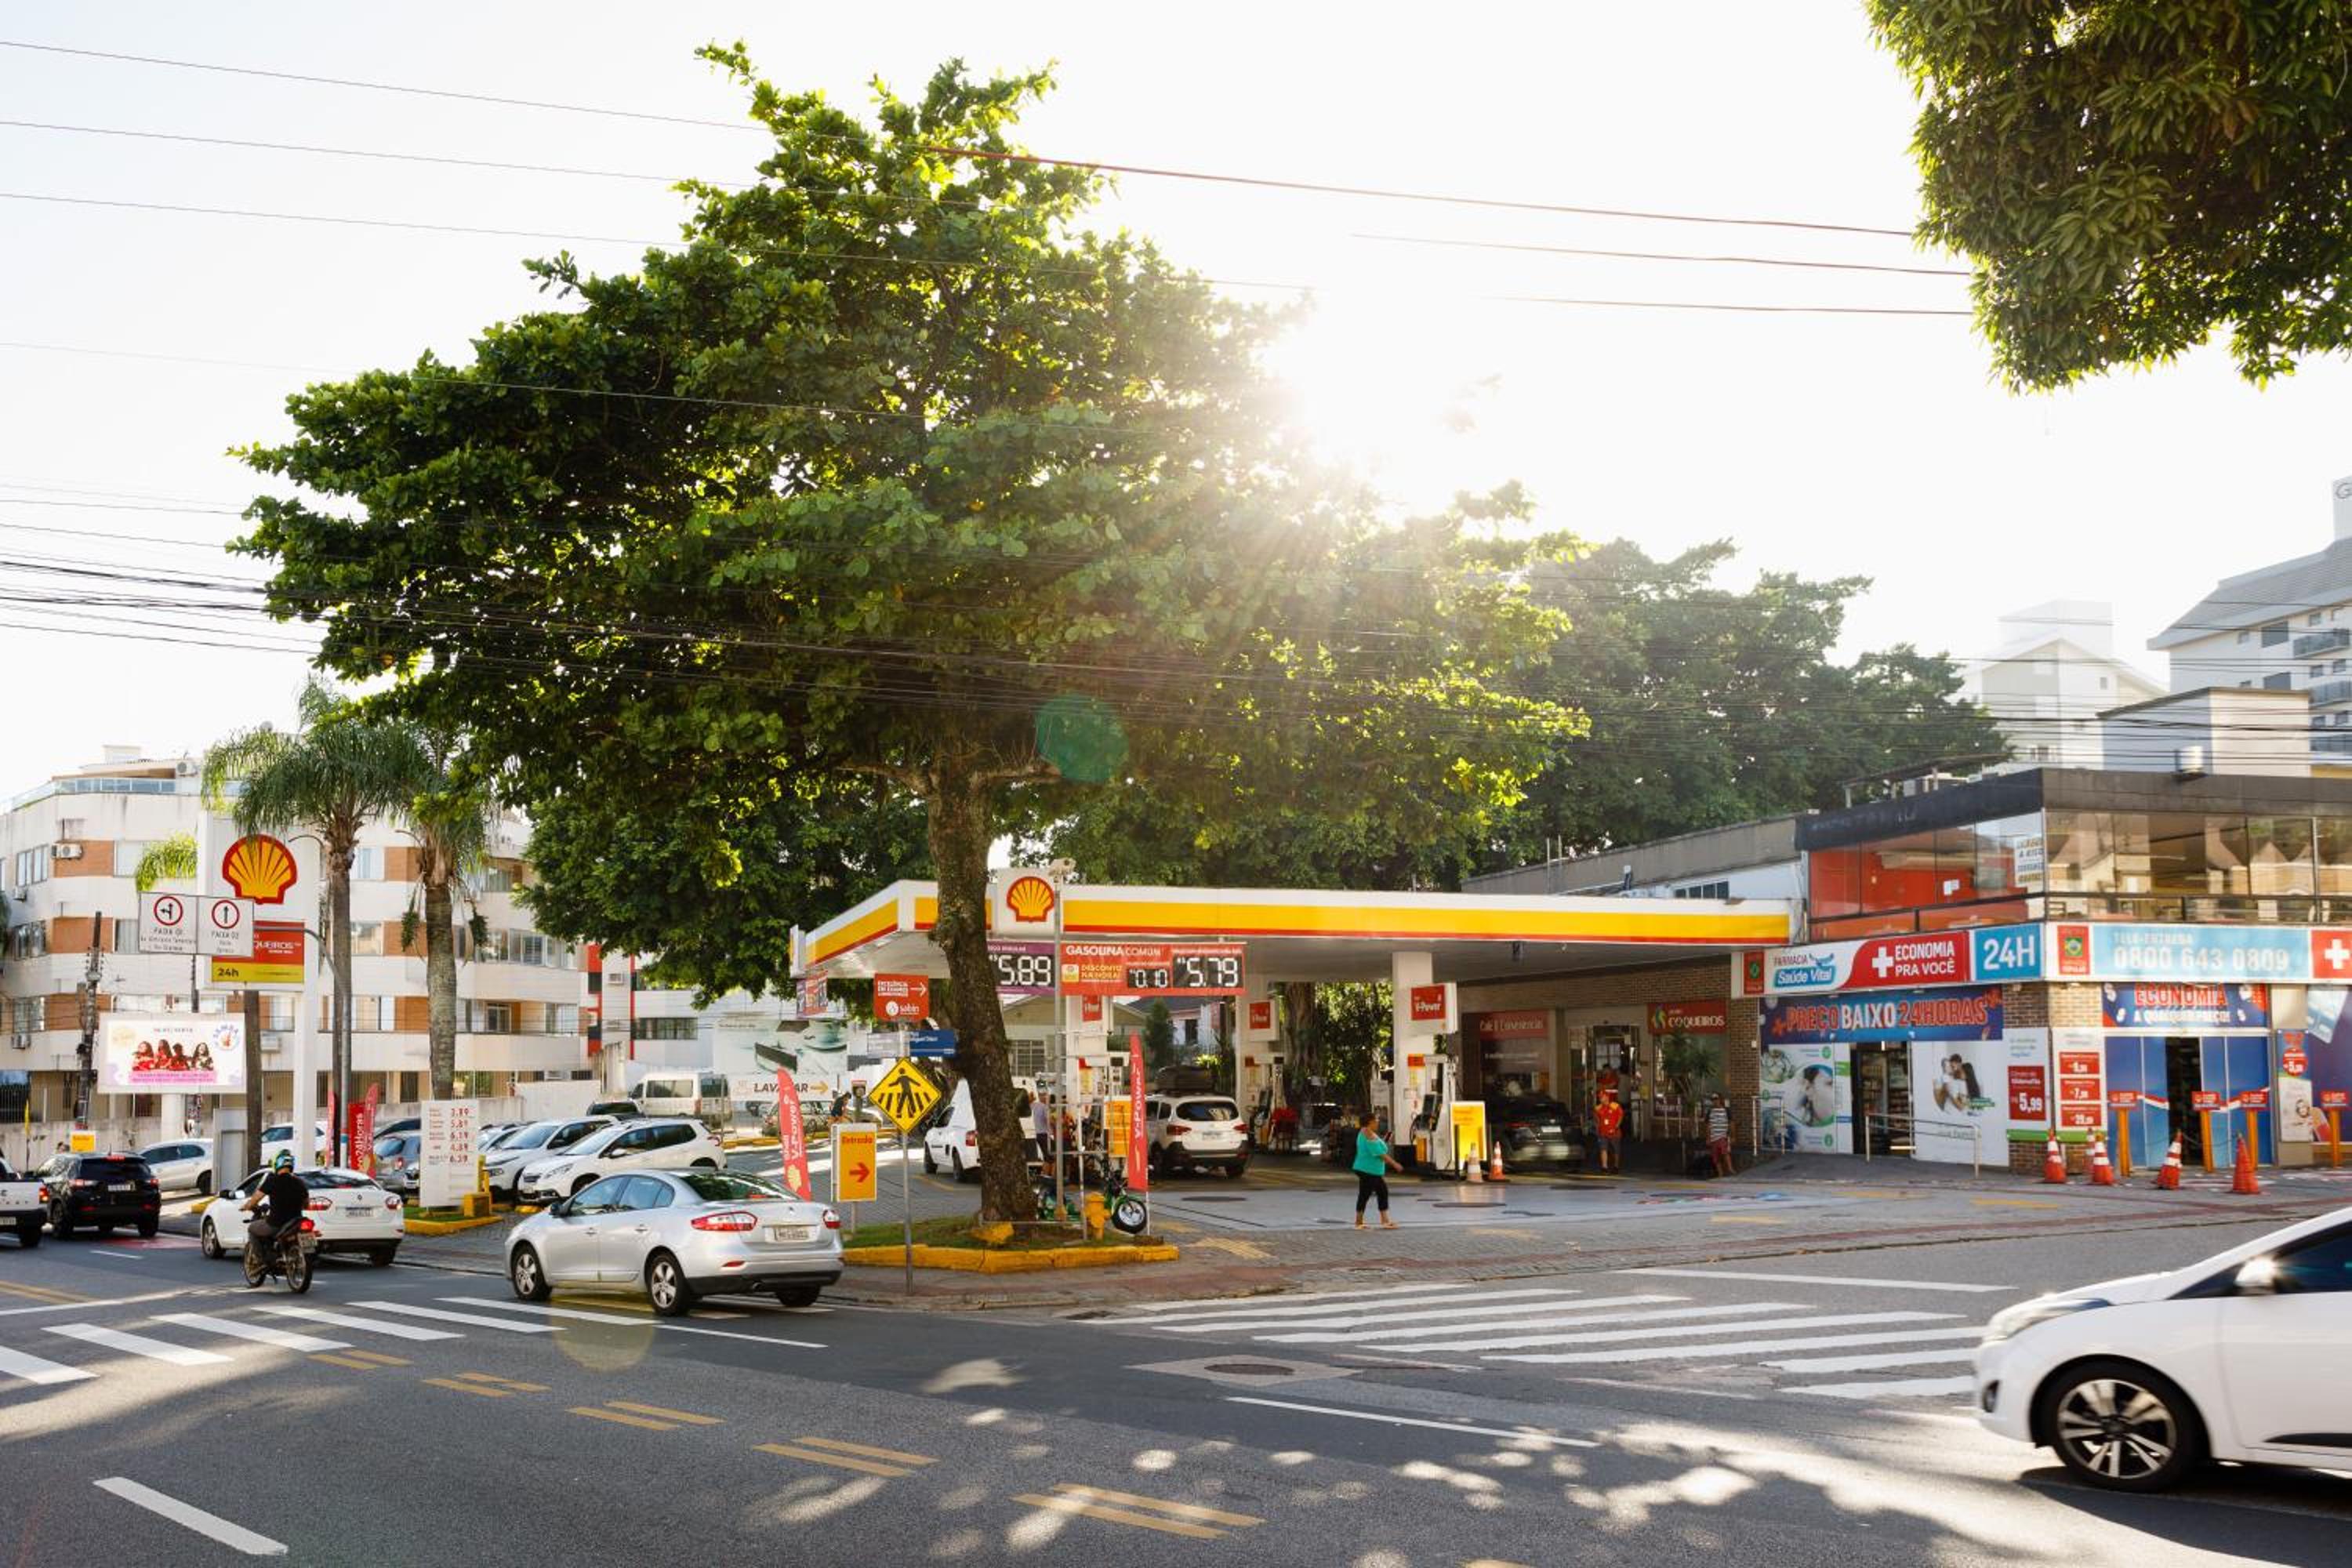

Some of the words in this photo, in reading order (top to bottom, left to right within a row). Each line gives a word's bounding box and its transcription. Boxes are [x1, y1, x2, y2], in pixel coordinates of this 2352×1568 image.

[1065, 945, 1125, 956] GASOLINA
[1895, 940, 1955, 961] ECONOMIA
[1983, 935, 2036, 971] 24H
[2114, 946, 2172, 969] 0800
[2181, 946, 2223, 971] 643
[2232, 947, 2290, 972] 0809
[217, 967, 239, 977] 24h
[1777, 969, 1808, 984] Saúde
[1809, 967, 1833, 980] Vital
[1895, 964, 1919, 977] PRA
[1922, 958, 1955, 975] VOCÊ
[2134, 982, 2229, 1008] ECONOMIA
[1668, 1015, 1726, 1029] COQUEIROS
[1786, 1004, 1838, 1033] PREÇO
[1842, 1002, 1896, 1029] BAIXO
[753, 1081, 808, 1094] LAVAR
[2019, 1092, 2043, 1113] 5,99
[789, 1099, 800, 1160] V-Power
